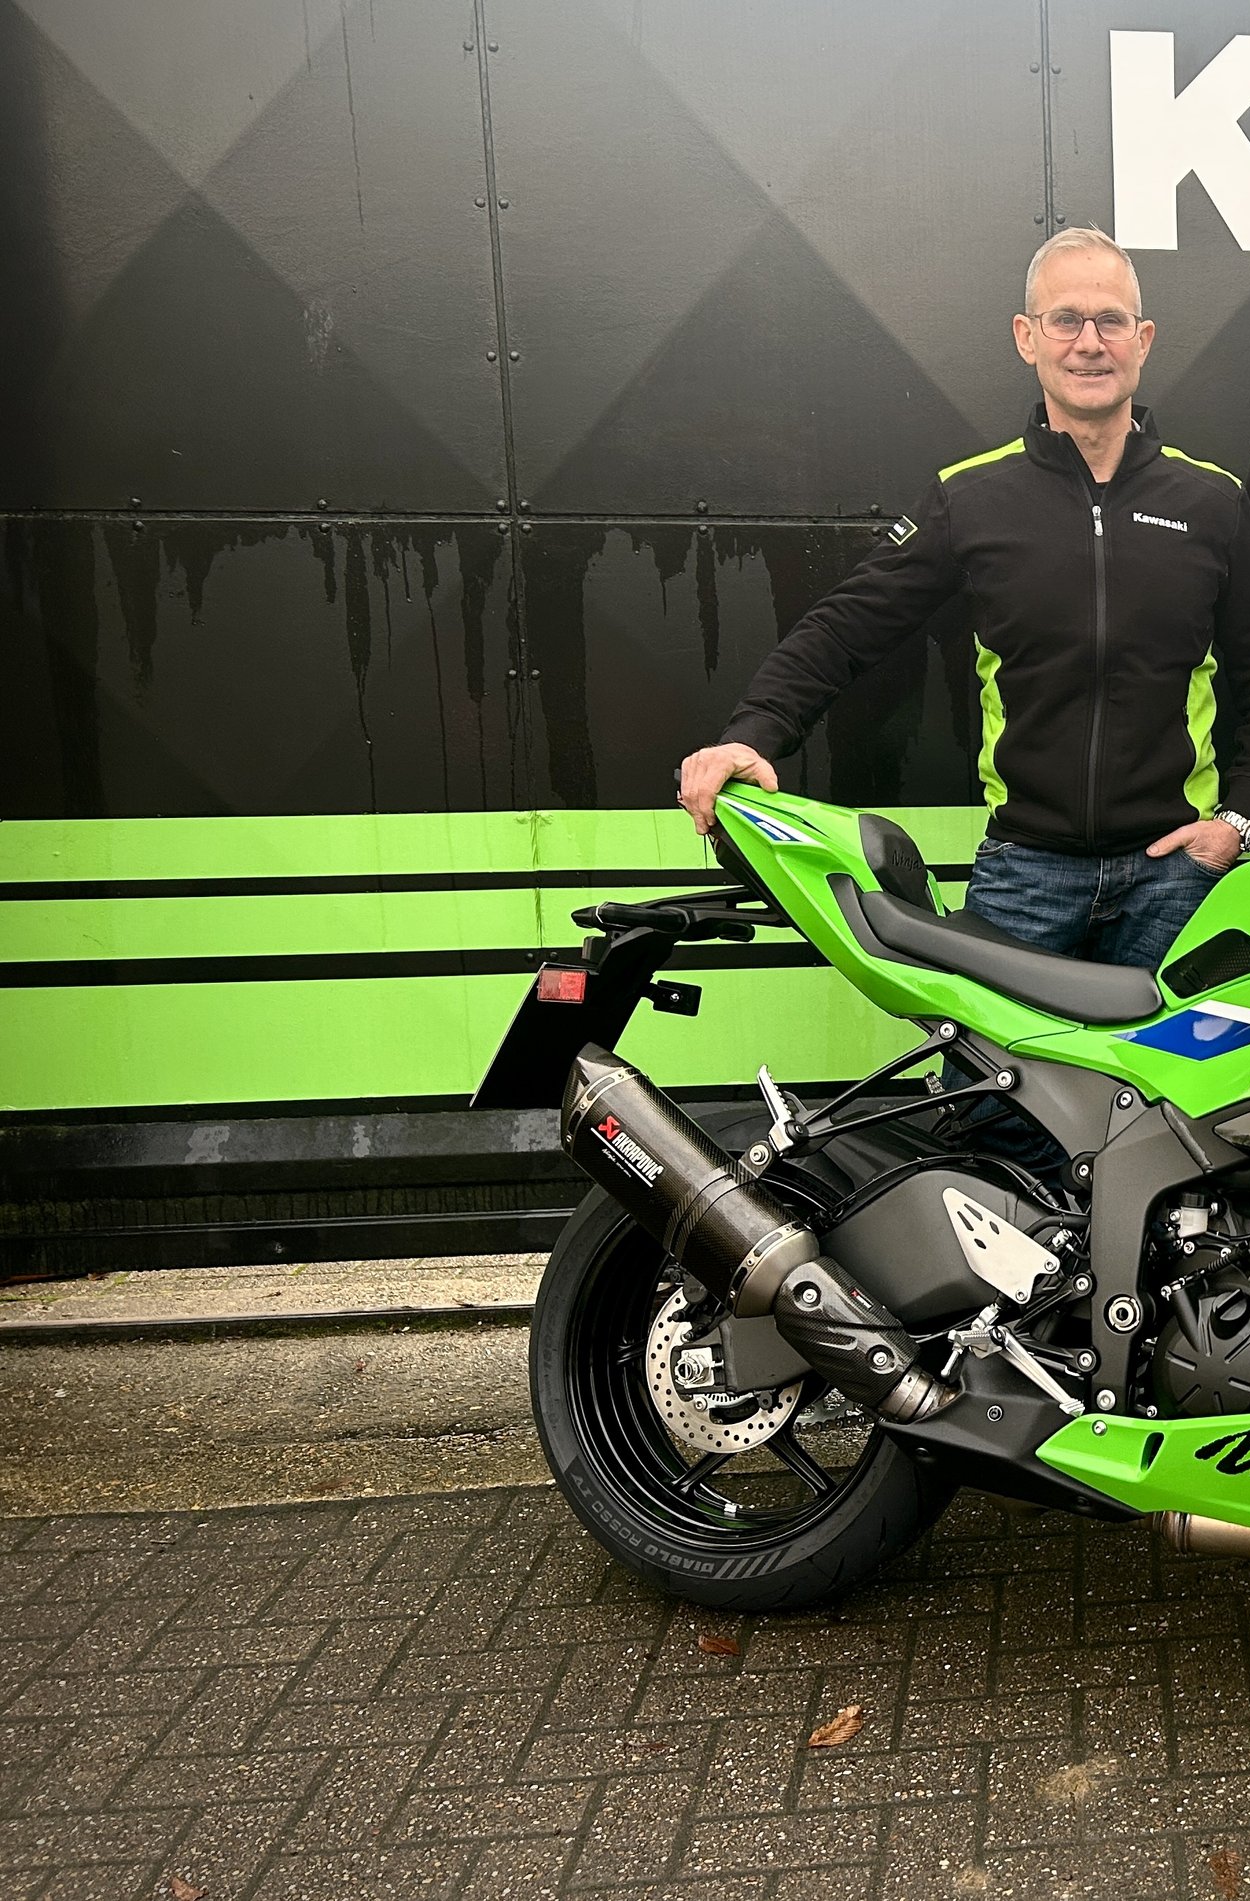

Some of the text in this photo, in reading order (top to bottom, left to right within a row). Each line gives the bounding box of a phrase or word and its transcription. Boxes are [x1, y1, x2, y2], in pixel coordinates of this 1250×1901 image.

[1132, 511, 1188, 532] Kawasaki
[591, 1500, 644, 1548] ROSSO
[644, 1544, 715, 1574] DIABLO
